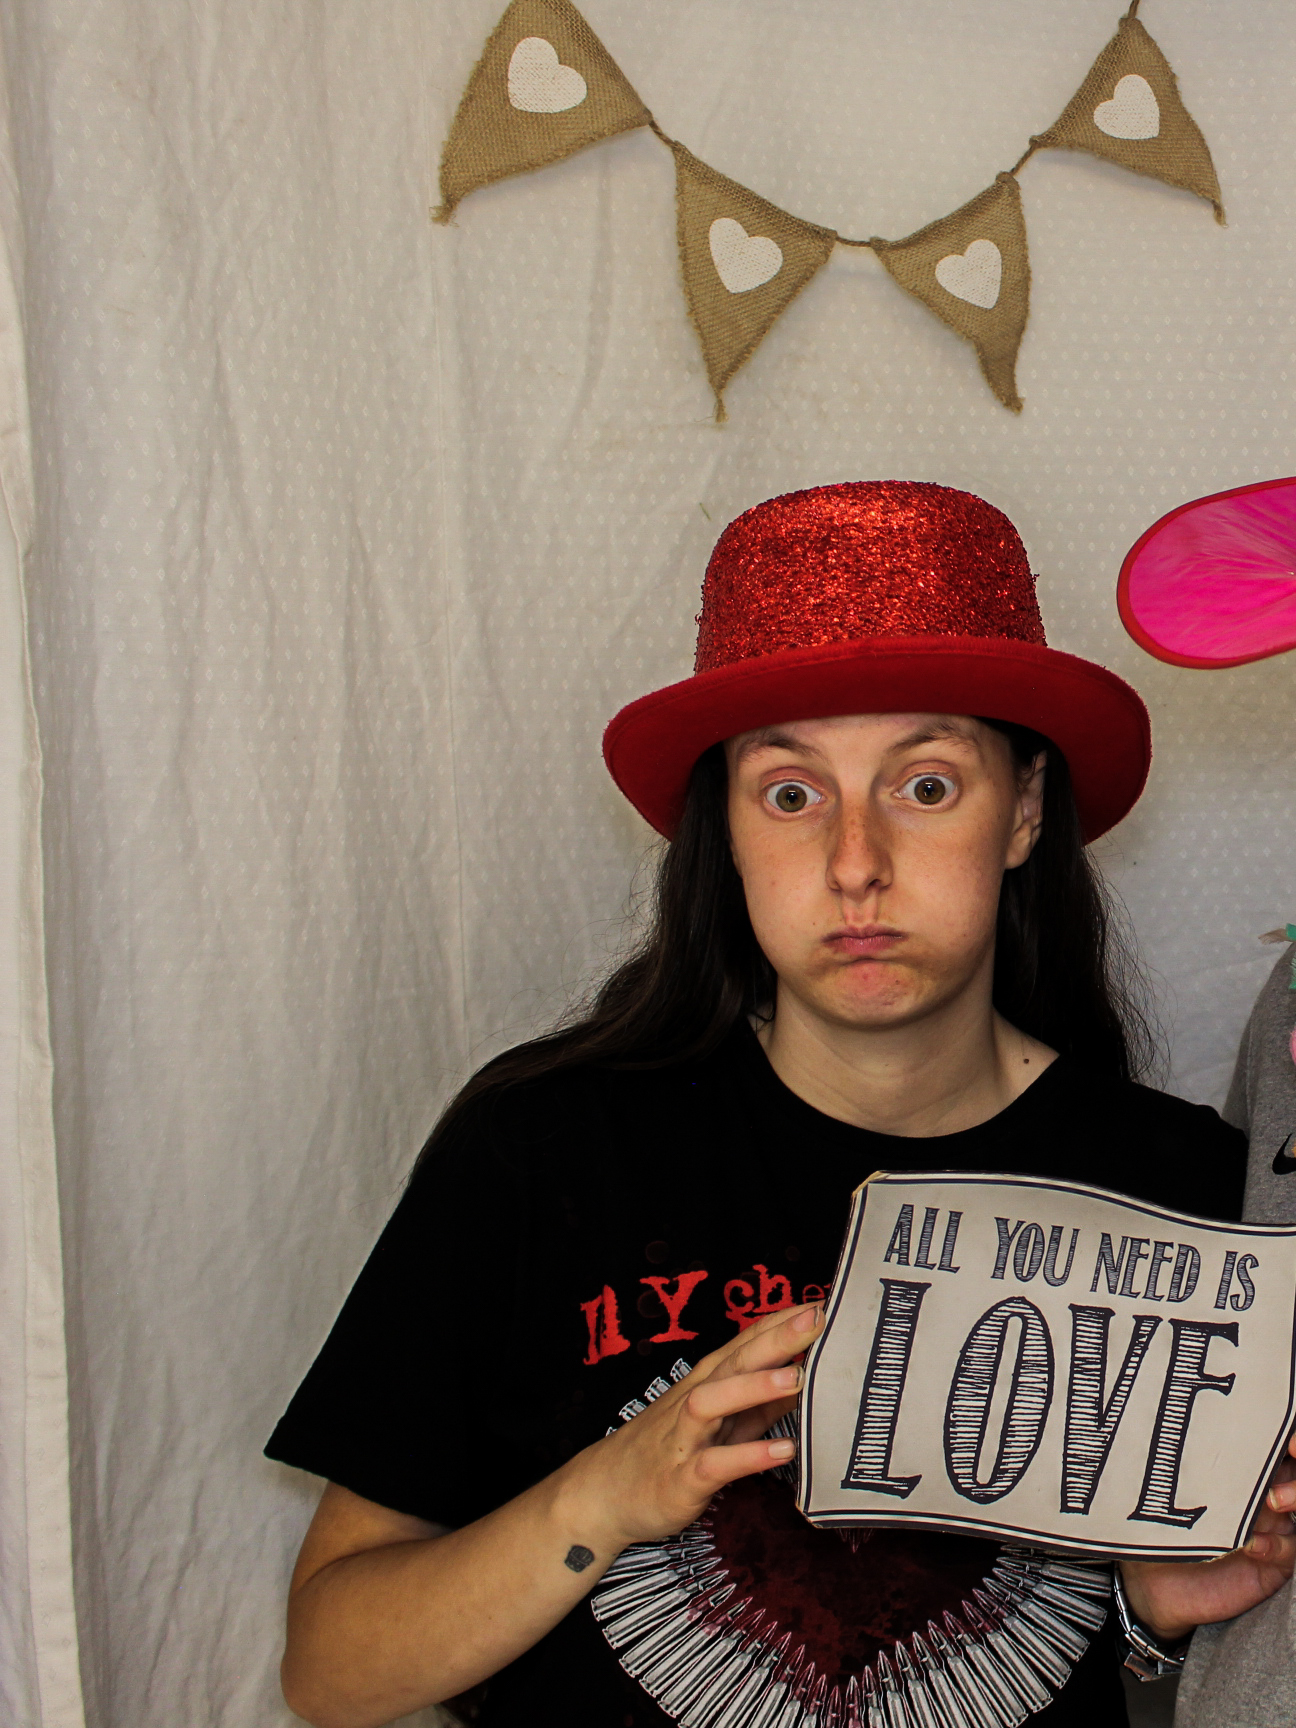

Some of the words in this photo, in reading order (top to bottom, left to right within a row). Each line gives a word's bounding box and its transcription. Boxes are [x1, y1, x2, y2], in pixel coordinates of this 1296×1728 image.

[883, 1203, 963, 1273] ALL
[990, 1217, 1080, 1286] YOU
[1090, 1233, 1201, 1303] NEED
[1213, 1251, 1260, 1311] IS
[840, 1277, 1239, 1529] LOVE
